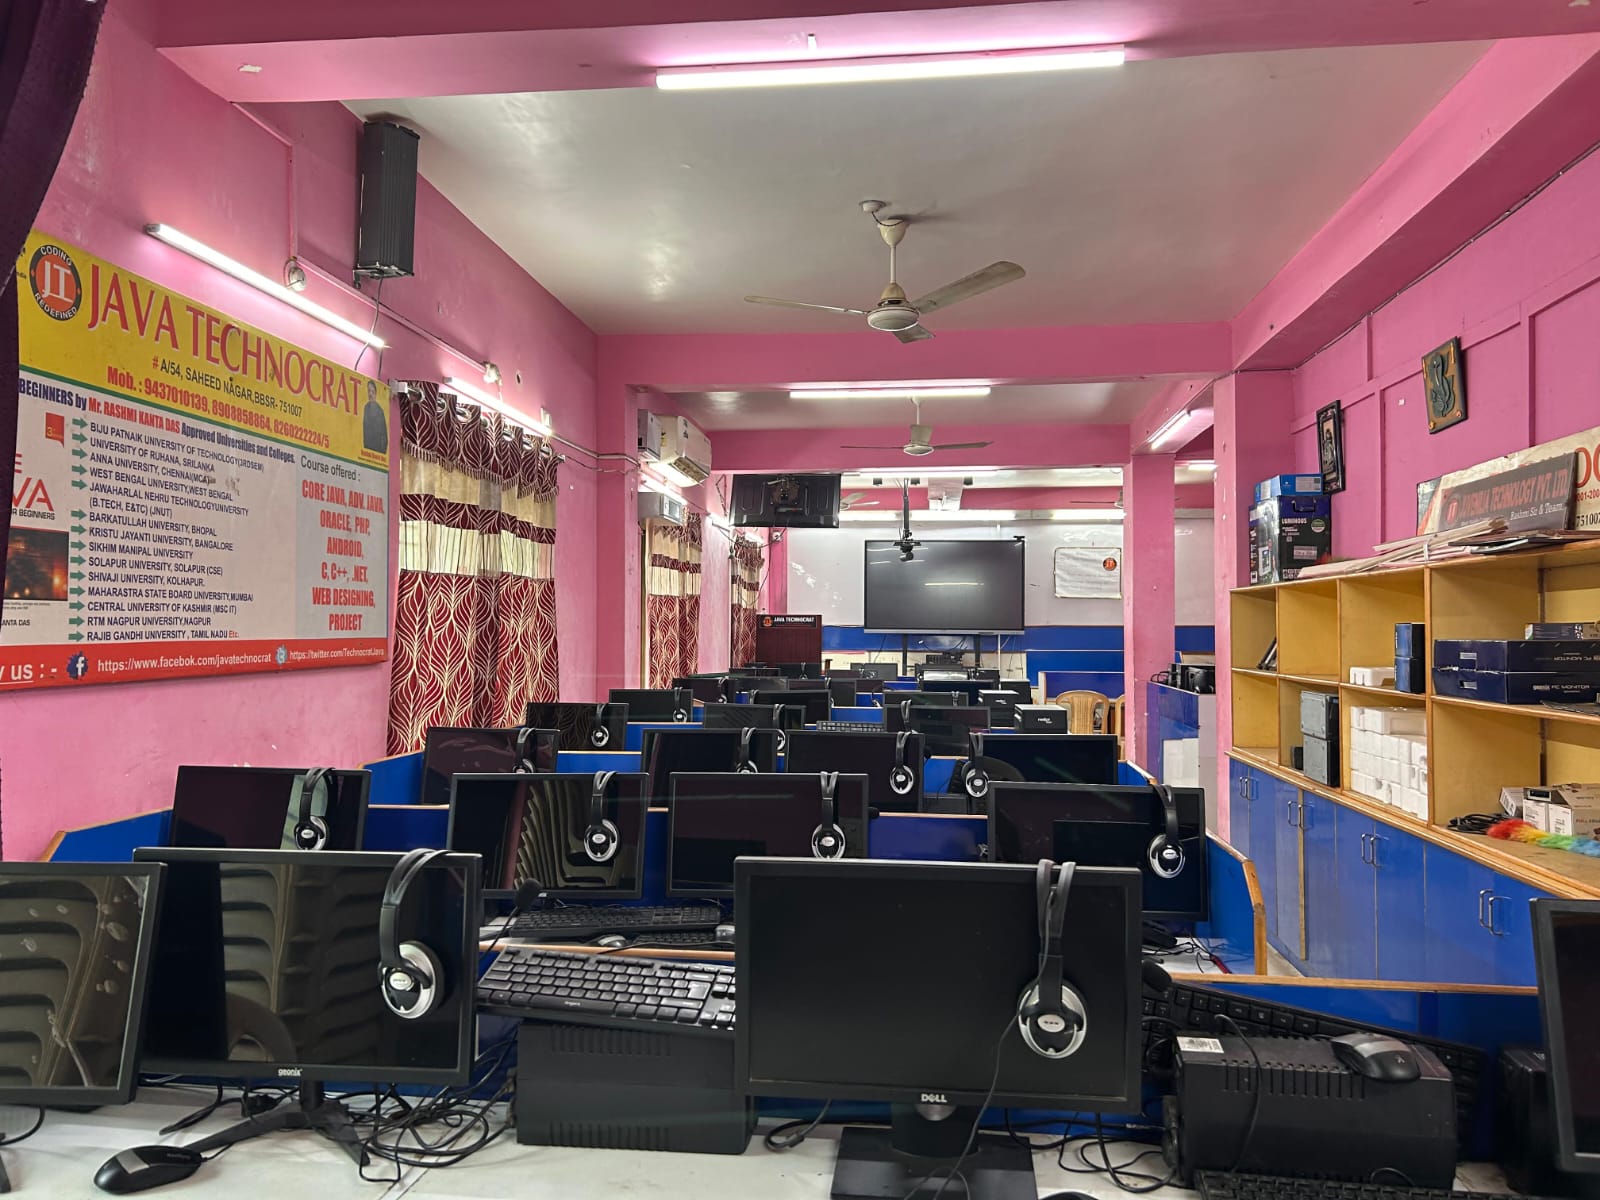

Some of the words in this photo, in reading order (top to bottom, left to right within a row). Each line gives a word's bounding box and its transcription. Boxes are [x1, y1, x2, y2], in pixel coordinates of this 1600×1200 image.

[40, 245, 73, 266] CODING
[34, 292, 78, 319] REDEFINED
[87, 263, 180, 352] JAVA
[186, 304, 362, 417] TECHNOCRAT
[107, 366, 136, 391] Mob.
[186, 367, 222, 390] SAHEED
[279, 400, 303, 417] 751007
[18, 378, 74, 407] BEGINNERS
[75, 392, 87, 411] by
[88, 397, 102, 414] Mr.
[103, 401, 137, 423] RASHMI
[139, 411, 164, 430] KANTA
[165, 417, 181, 434] DAS
[181, 422, 216, 444] Approved
[216, 432, 256, 454] Universities
[256, 444, 268, 457] and
[90, 422, 109, 435] BIJU
[110, 427, 143, 443] PATNAIK
[144, 435, 186, 452] UNIVERSITY
[186, 445, 196, 455] OF
[90, 437, 137, 455] UNIVERSITY
[138, 447, 149, 457] OF
[182, 457, 215, 472] SRILANKA
[90, 452, 113, 466] ANNA
[114, 457, 160, 476] UNIVERSITY,
[300, 455, 329, 474] Course
[330, 463, 357, 480] offered
[89, 467, 113, 479] WEST
[114, 471, 147, 486] BENGAL
[208, 489, 234, 501] BENGAL
[89, 482, 143, 500] JAWAHARLAL
[144, 490, 169, 504] NEHRU
[302, 479, 325, 502] CORE
[19, 508, 56, 521] BEGINNERS
[89, 511, 147, 528] BARKATULLAH
[148, 519, 191, 535] UNIVERSITY,
[191, 525, 217, 537] BHOPAL
[89, 527, 119, 539] KRISTU
[120, 531, 151, 542] JAYANTI
[152, 533, 194, 548] UNIVERSITY,
[194, 539, 234, 551] BANGALORE
[88, 541, 117, 553] SIKHIM
[118, 544, 152, 556] MANIPAL
[153, 548, 194, 560] UNIVERSITY
[88, 556, 127, 569] SOLAPUR
[128, 559, 173, 573] UNIVERSITY,
[174, 563, 206, 574] SOLAPUR
[206, 566, 223, 576] (CSE)
[88, 571, 119, 582] SHIVAJI
[120, 574, 165, 585] UNIVERSITY,
[87, 586, 143, 598] MAHARASTRA
[144, 588, 167, 598] STATE
[168, 589, 193, 600] BOARD
[312, 586, 332, 606] WEB
[87, 601, 126, 611] CENTRAL
[127, 602, 170, 612] UNIVERSITY
[171, 603, 181, 612] OF
[182, 604, 212, 613] KASHMIR
[87, 616, 105, 626] RTM
[106, 616, 141, 626] NAGPUR
[328, 613, 363, 631] PROJECT
[87, 631, 112, 641] RAJIB
[113, 630, 144, 641] GANDHI
[191, 629, 209, 639] TAMIL
[210, 629, 228, 639] NADU
[11, 663, 34, 680] us
[920, 1093, 948, 1103] DELL
